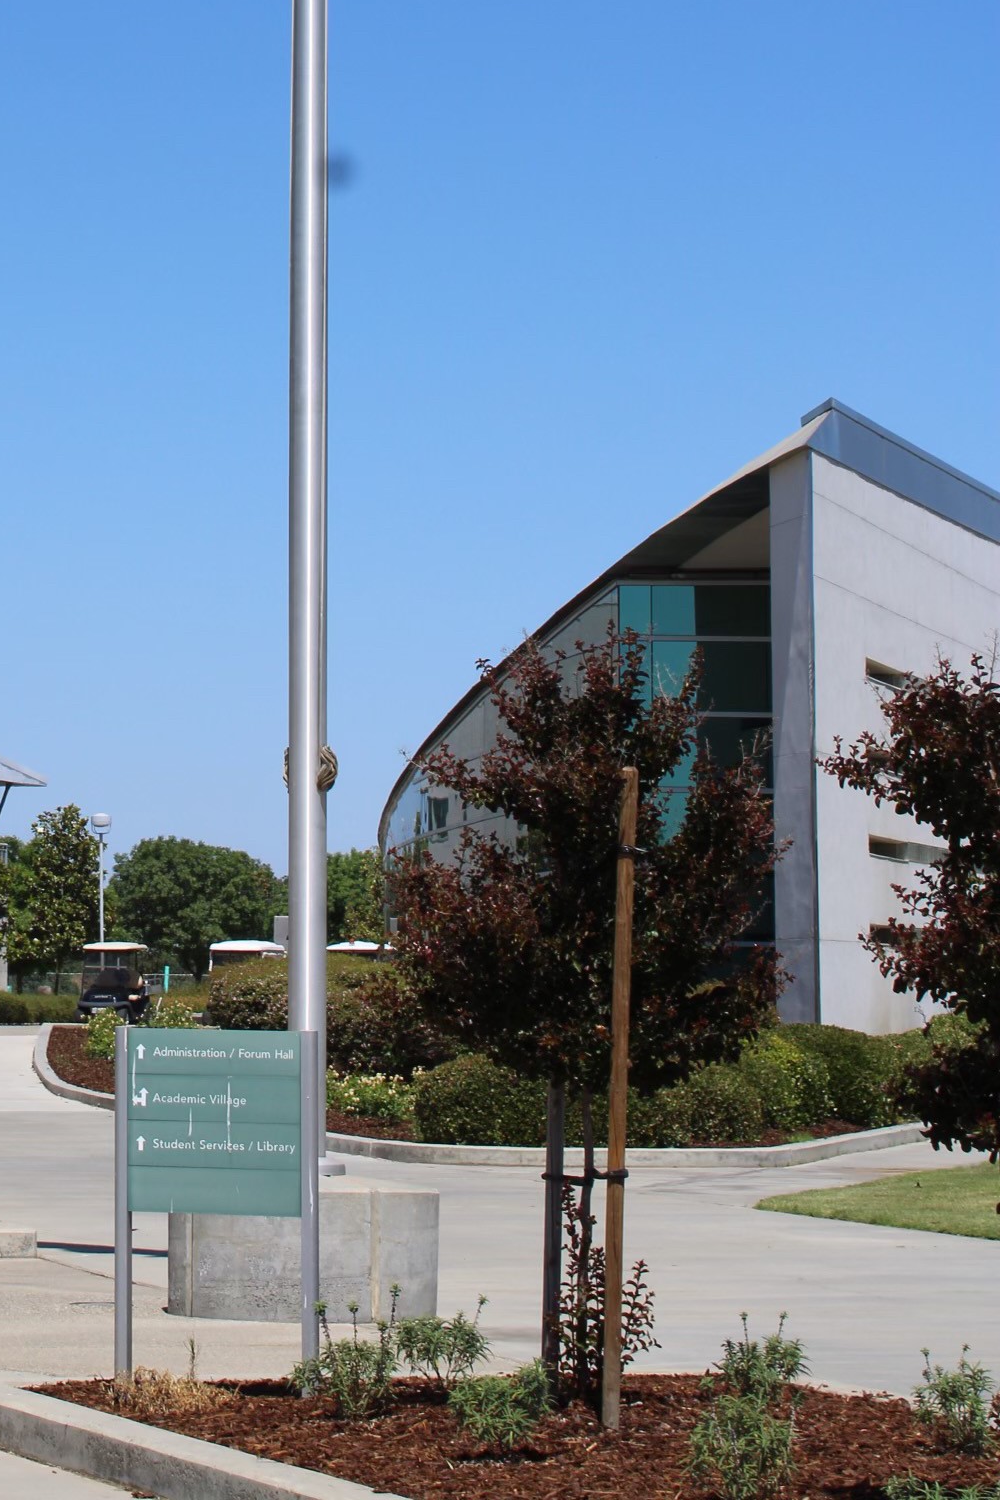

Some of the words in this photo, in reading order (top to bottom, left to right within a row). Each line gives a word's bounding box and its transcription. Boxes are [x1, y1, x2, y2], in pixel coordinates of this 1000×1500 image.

[152, 1046, 226, 1058] Administration
[229, 1048, 235, 1059] /
[238, 1049, 271, 1059] Forum
[274, 1049, 294, 1060] Hall
[152, 1092, 206, 1104] Academic
[209, 1094, 247, 1108] Village
[152, 1138, 196, 1150] Student
[199, 1140, 245, 1151] Services
[248, 1141, 254, 1152] /
[257, 1141, 296, 1155] Library
